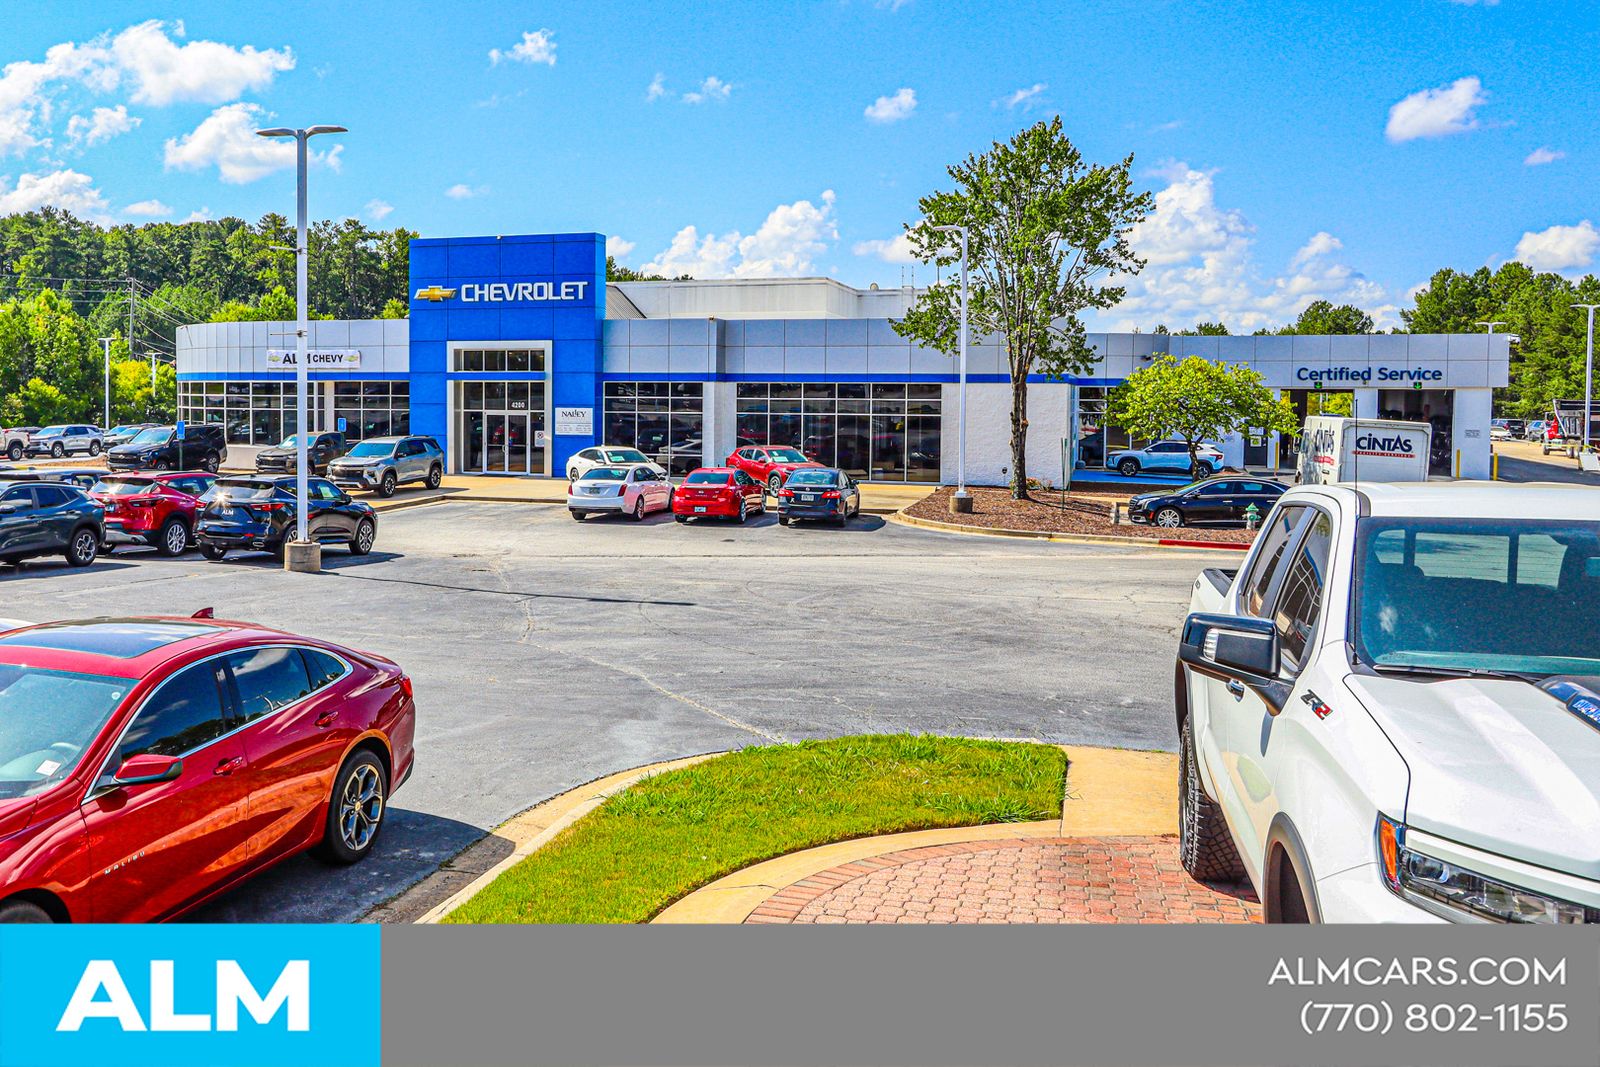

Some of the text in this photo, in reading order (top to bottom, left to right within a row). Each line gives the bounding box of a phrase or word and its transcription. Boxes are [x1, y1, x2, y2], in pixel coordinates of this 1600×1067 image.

[461, 281, 588, 302] CHEVROLET
[312, 354, 344, 363] CHEVY
[1297, 366, 1443, 381] Certified Service
[1300, 689, 1334, 721] ZR2
